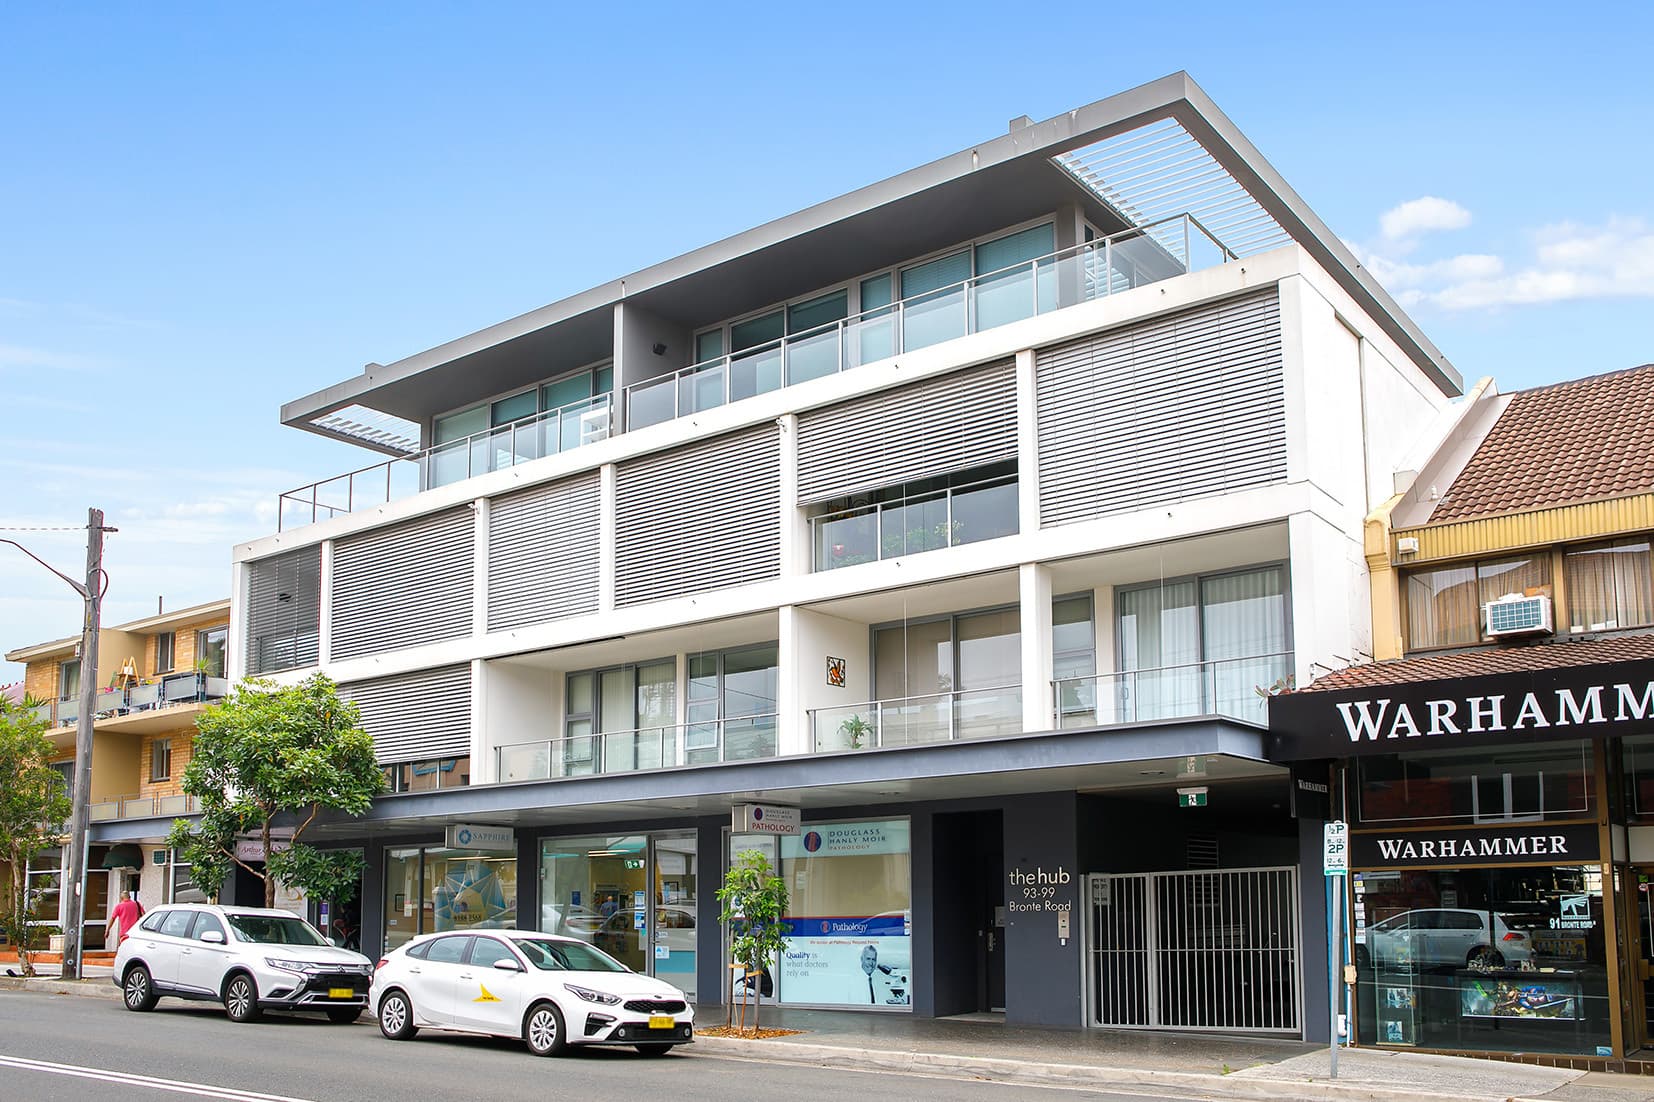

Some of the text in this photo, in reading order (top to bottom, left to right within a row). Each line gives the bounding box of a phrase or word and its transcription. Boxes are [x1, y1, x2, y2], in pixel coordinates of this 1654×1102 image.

[752, 822, 795, 832] PATHOLOGY
[472, 831, 510, 841] SAPPHIRE
[829, 829, 880, 837] DOUGLASS
[1328, 844, 1344, 854] 2P
[1377, 835, 1568, 860] WARHAMMER
[1023, 887, 1056, 898] 93-99
[1010, 900, 1071, 911] Bronte Road
[832, 922, 868, 933] Pathology
[1550, 918, 1560, 929] 91
[786, 951, 810, 959] Quality
[786, 970, 798, 978] rely
